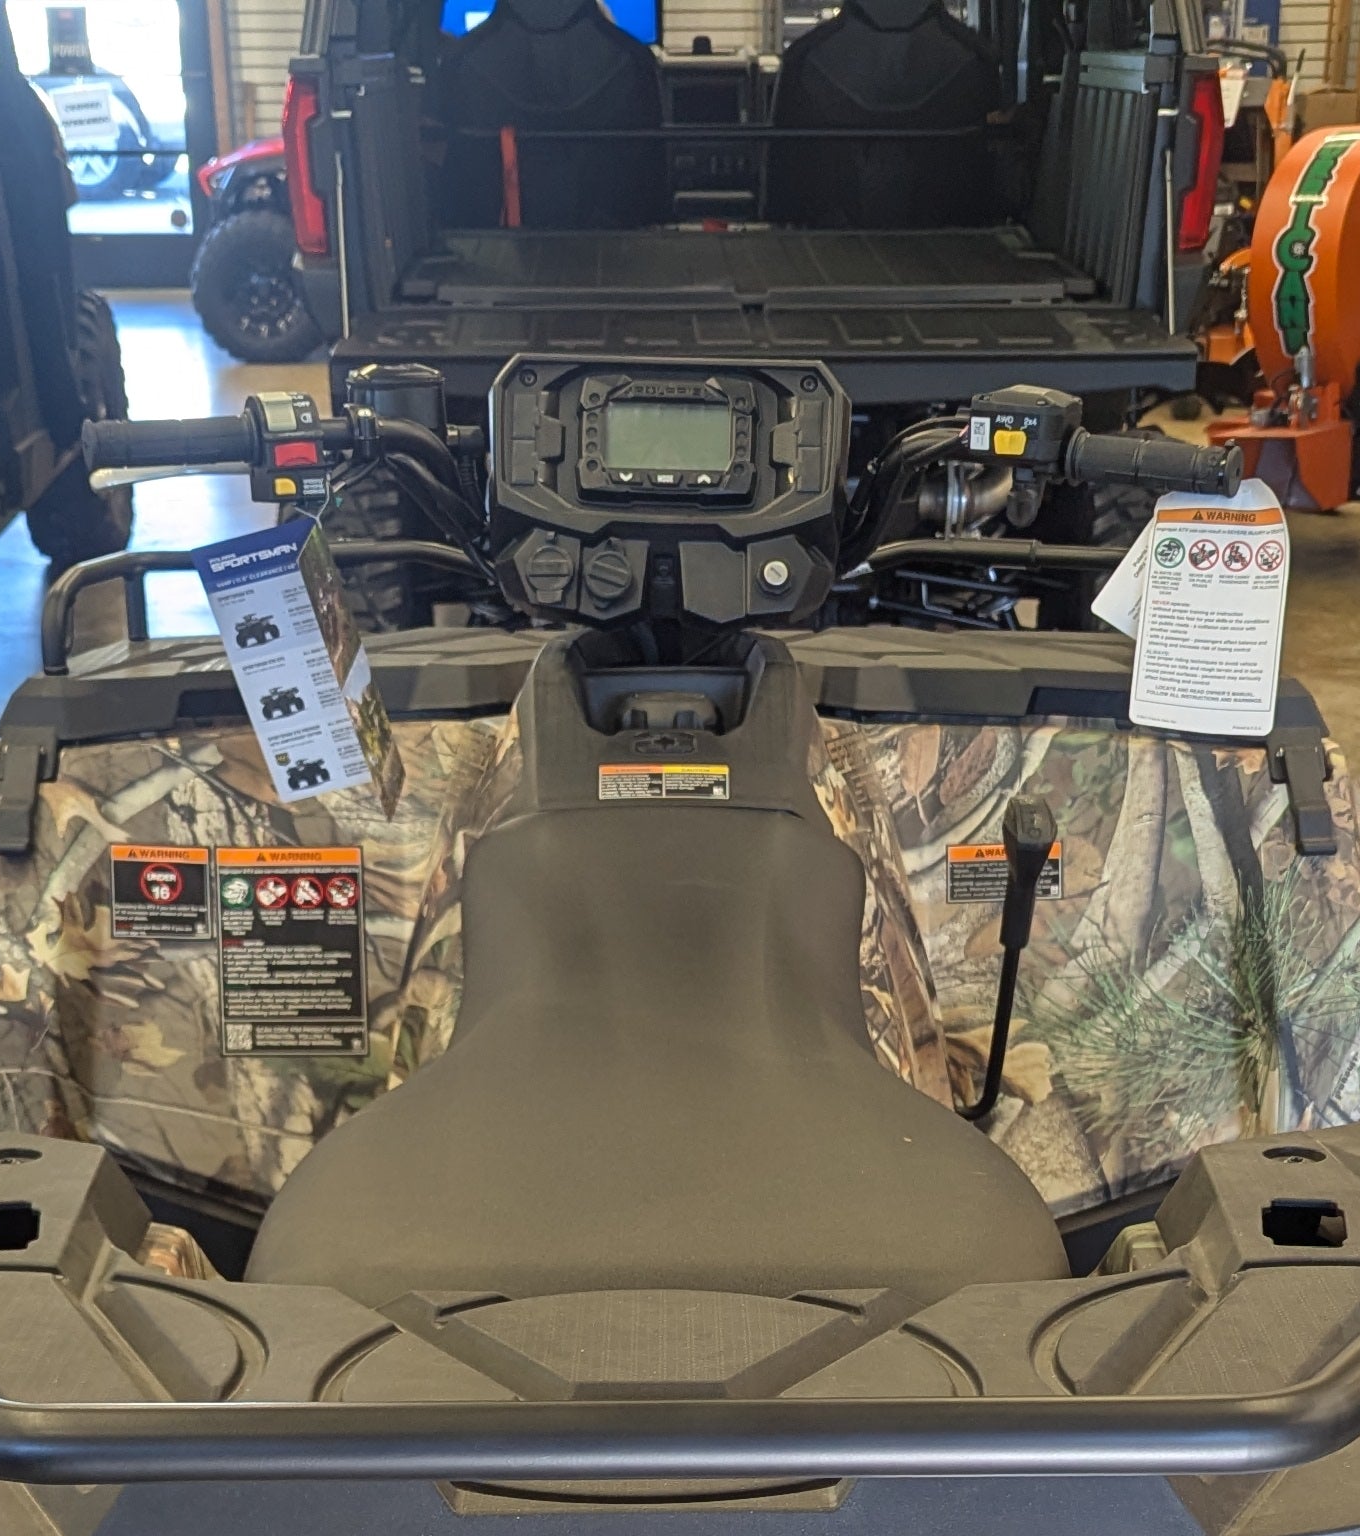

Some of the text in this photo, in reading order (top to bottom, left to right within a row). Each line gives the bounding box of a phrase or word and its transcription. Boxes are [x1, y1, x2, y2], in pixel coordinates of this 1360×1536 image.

[1206, 511, 1256, 523] WARNING
[210, 543, 298, 573] SPORTSMAN
[139, 849, 190, 859] WARNING
[269, 852, 322, 861] WARNING
[146, 872, 177, 882] UNDER
